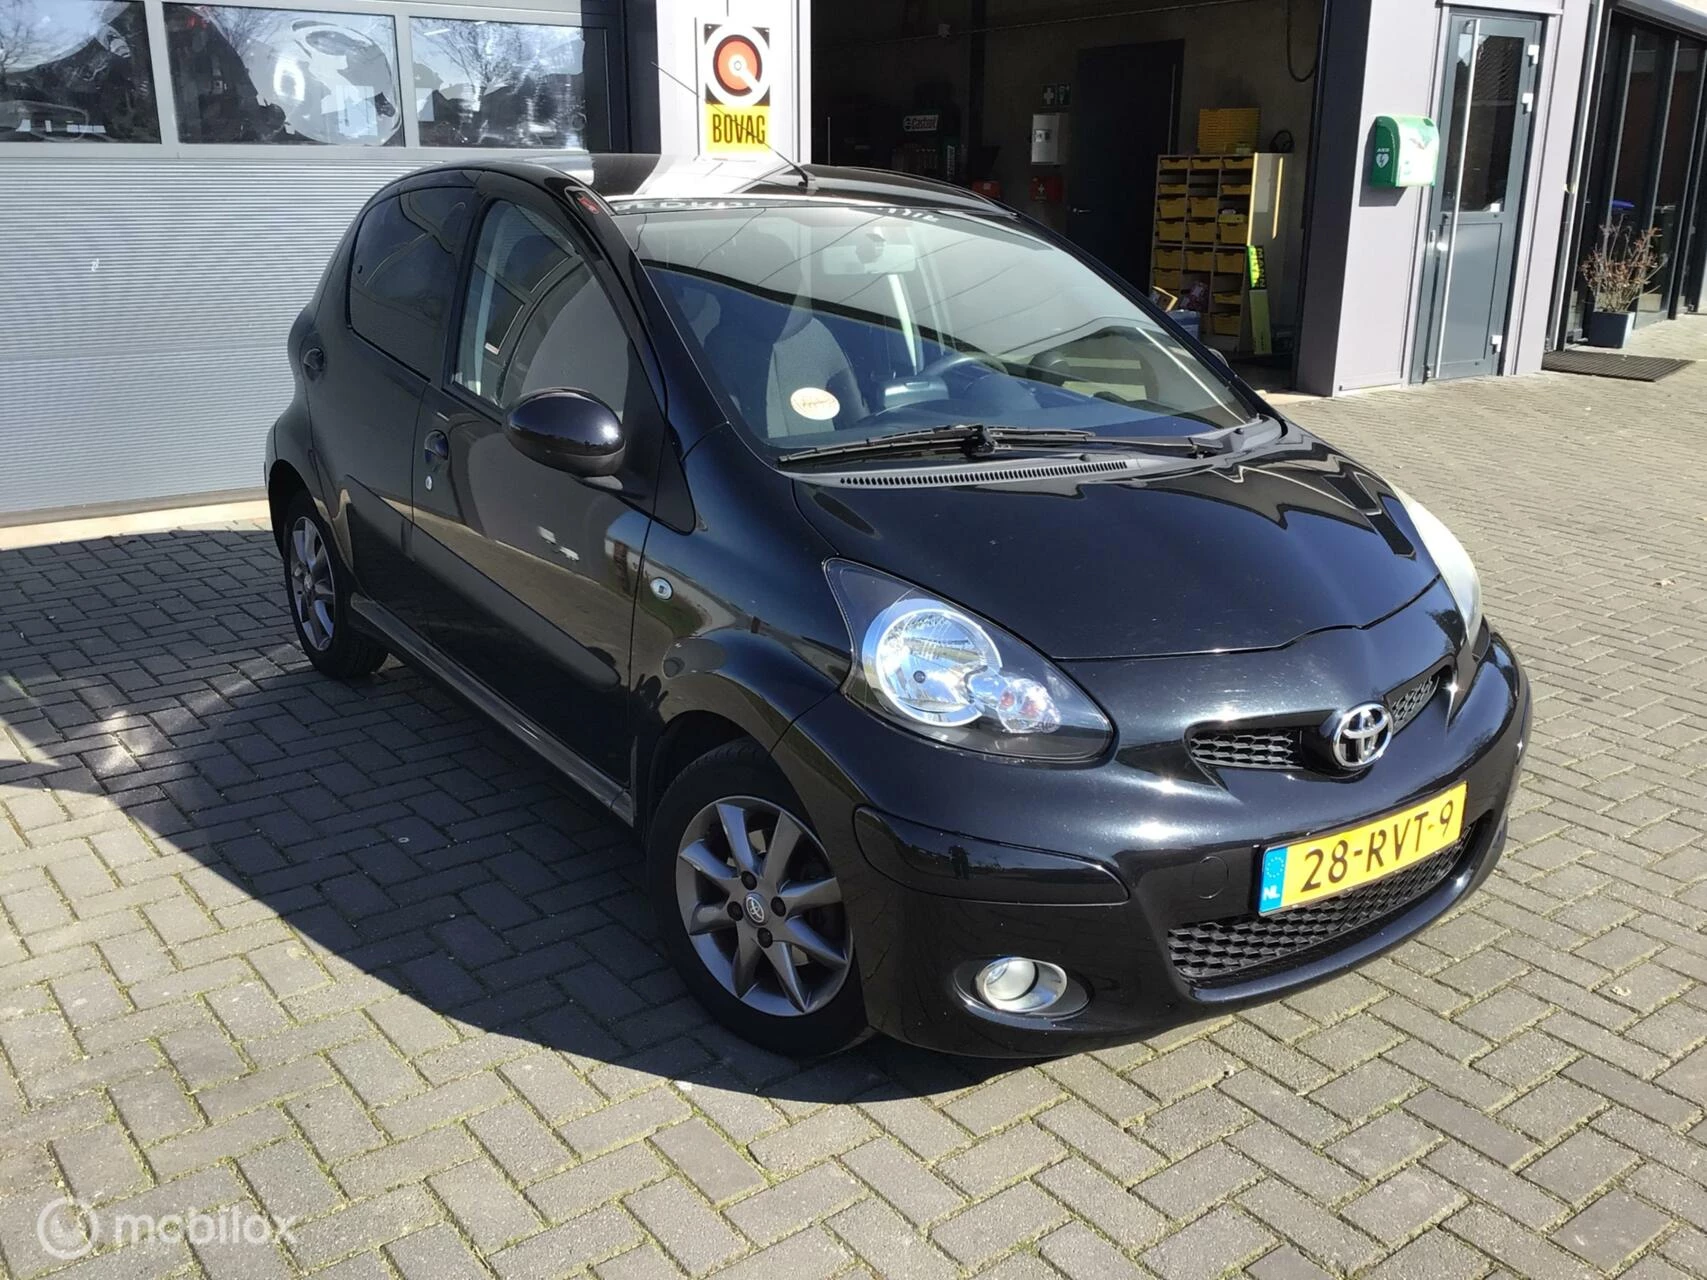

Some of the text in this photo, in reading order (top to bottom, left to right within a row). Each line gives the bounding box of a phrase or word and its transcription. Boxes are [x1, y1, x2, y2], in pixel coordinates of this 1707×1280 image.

[712, 113, 766, 144] BOVAG
[1301, 799, 1454, 893] 28-RVT-9
[1263, 885, 1280, 900] NL
